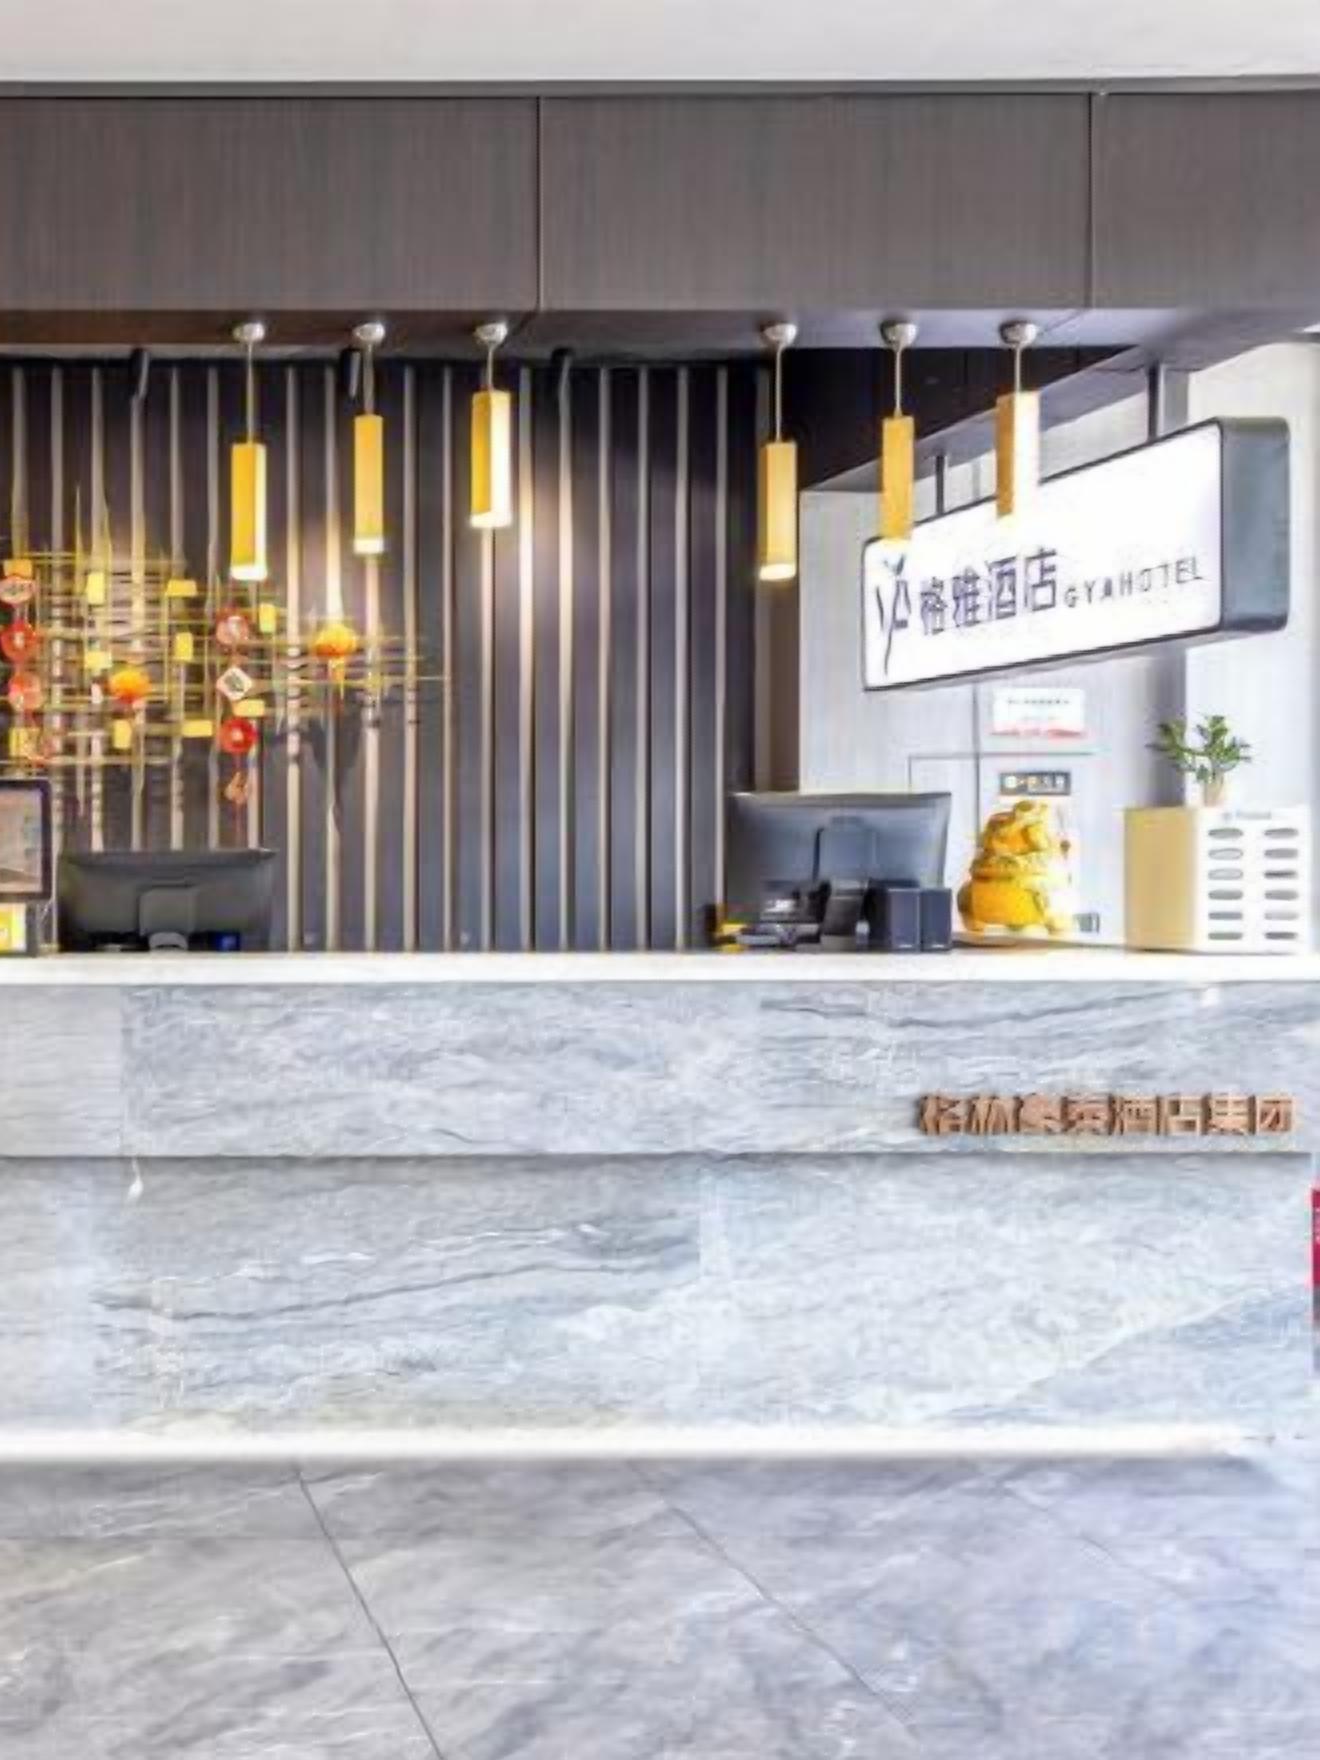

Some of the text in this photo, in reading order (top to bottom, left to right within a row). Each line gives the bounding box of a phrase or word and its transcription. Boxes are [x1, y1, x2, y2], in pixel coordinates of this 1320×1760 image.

[920, 548, 1204, 636] 格雅酒店 GYAHOTEL
